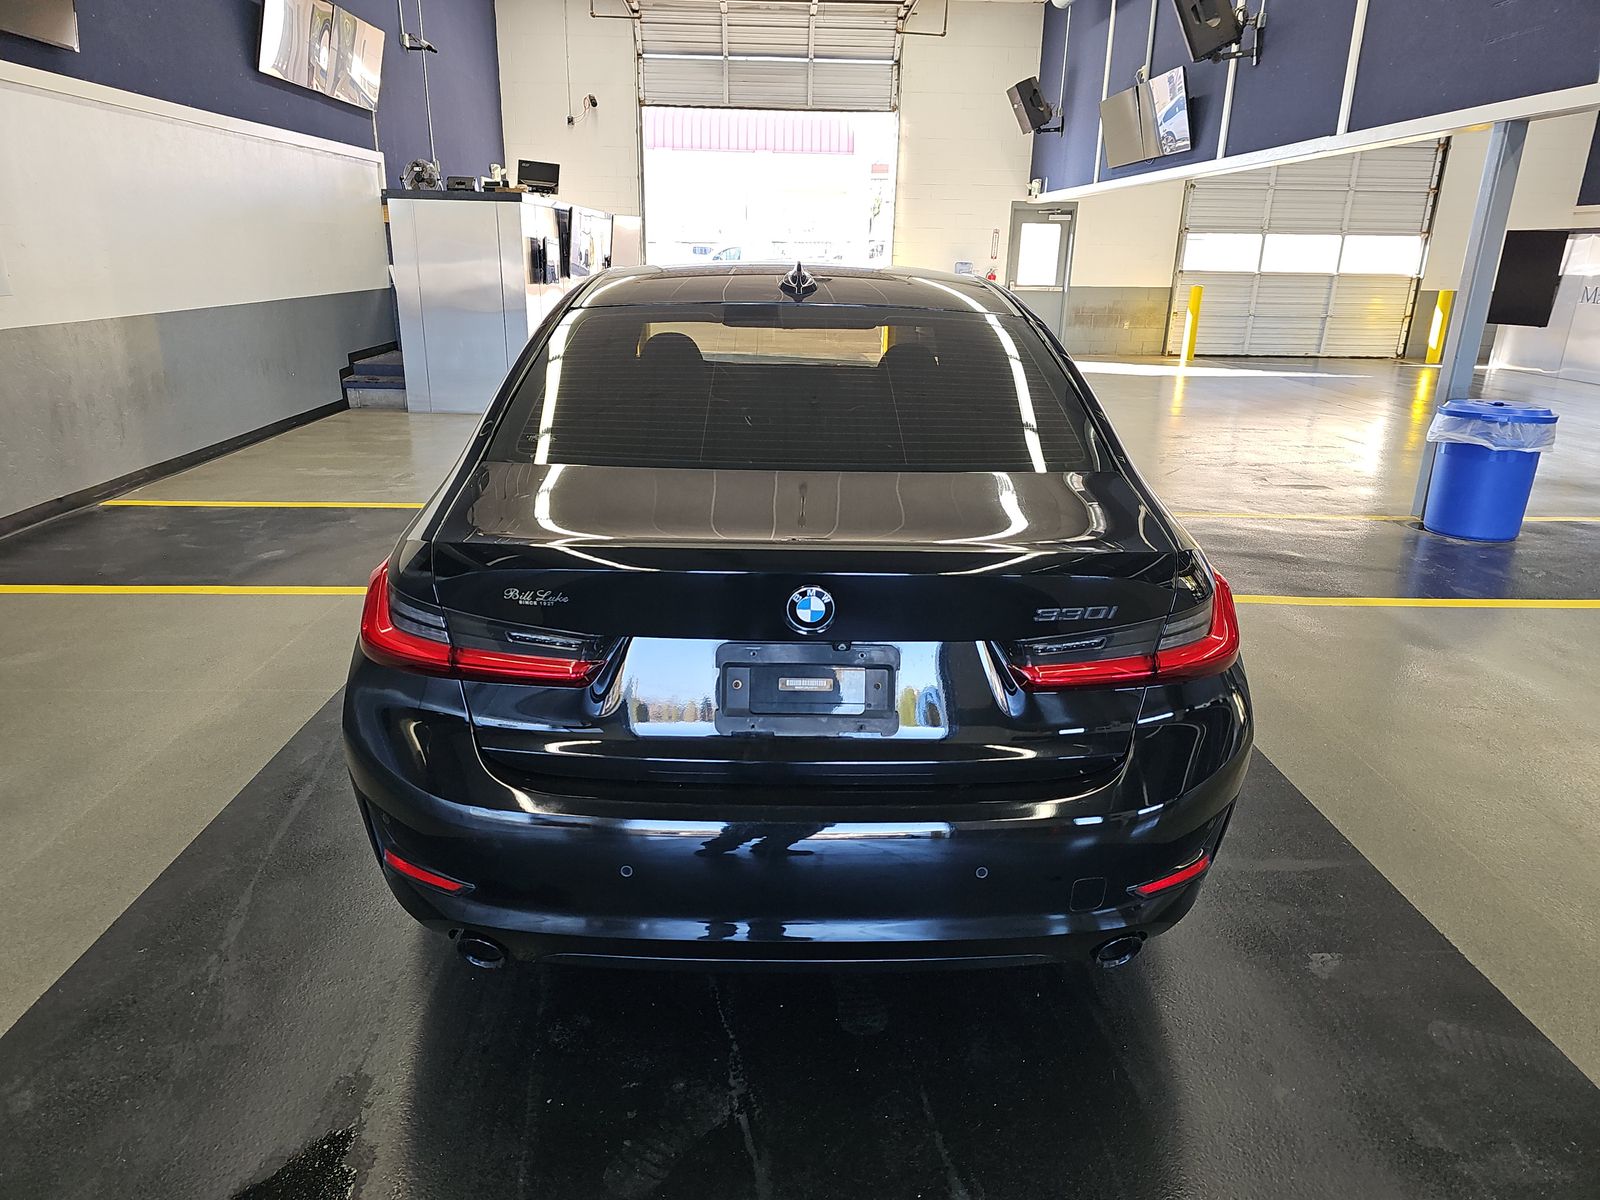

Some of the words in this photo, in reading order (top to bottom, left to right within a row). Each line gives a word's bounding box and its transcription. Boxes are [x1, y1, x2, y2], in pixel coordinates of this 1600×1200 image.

[504, 588, 534, 600] Bill
[536, 589, 569, 603] Luke
[792, 589, 830, 603] BMW
